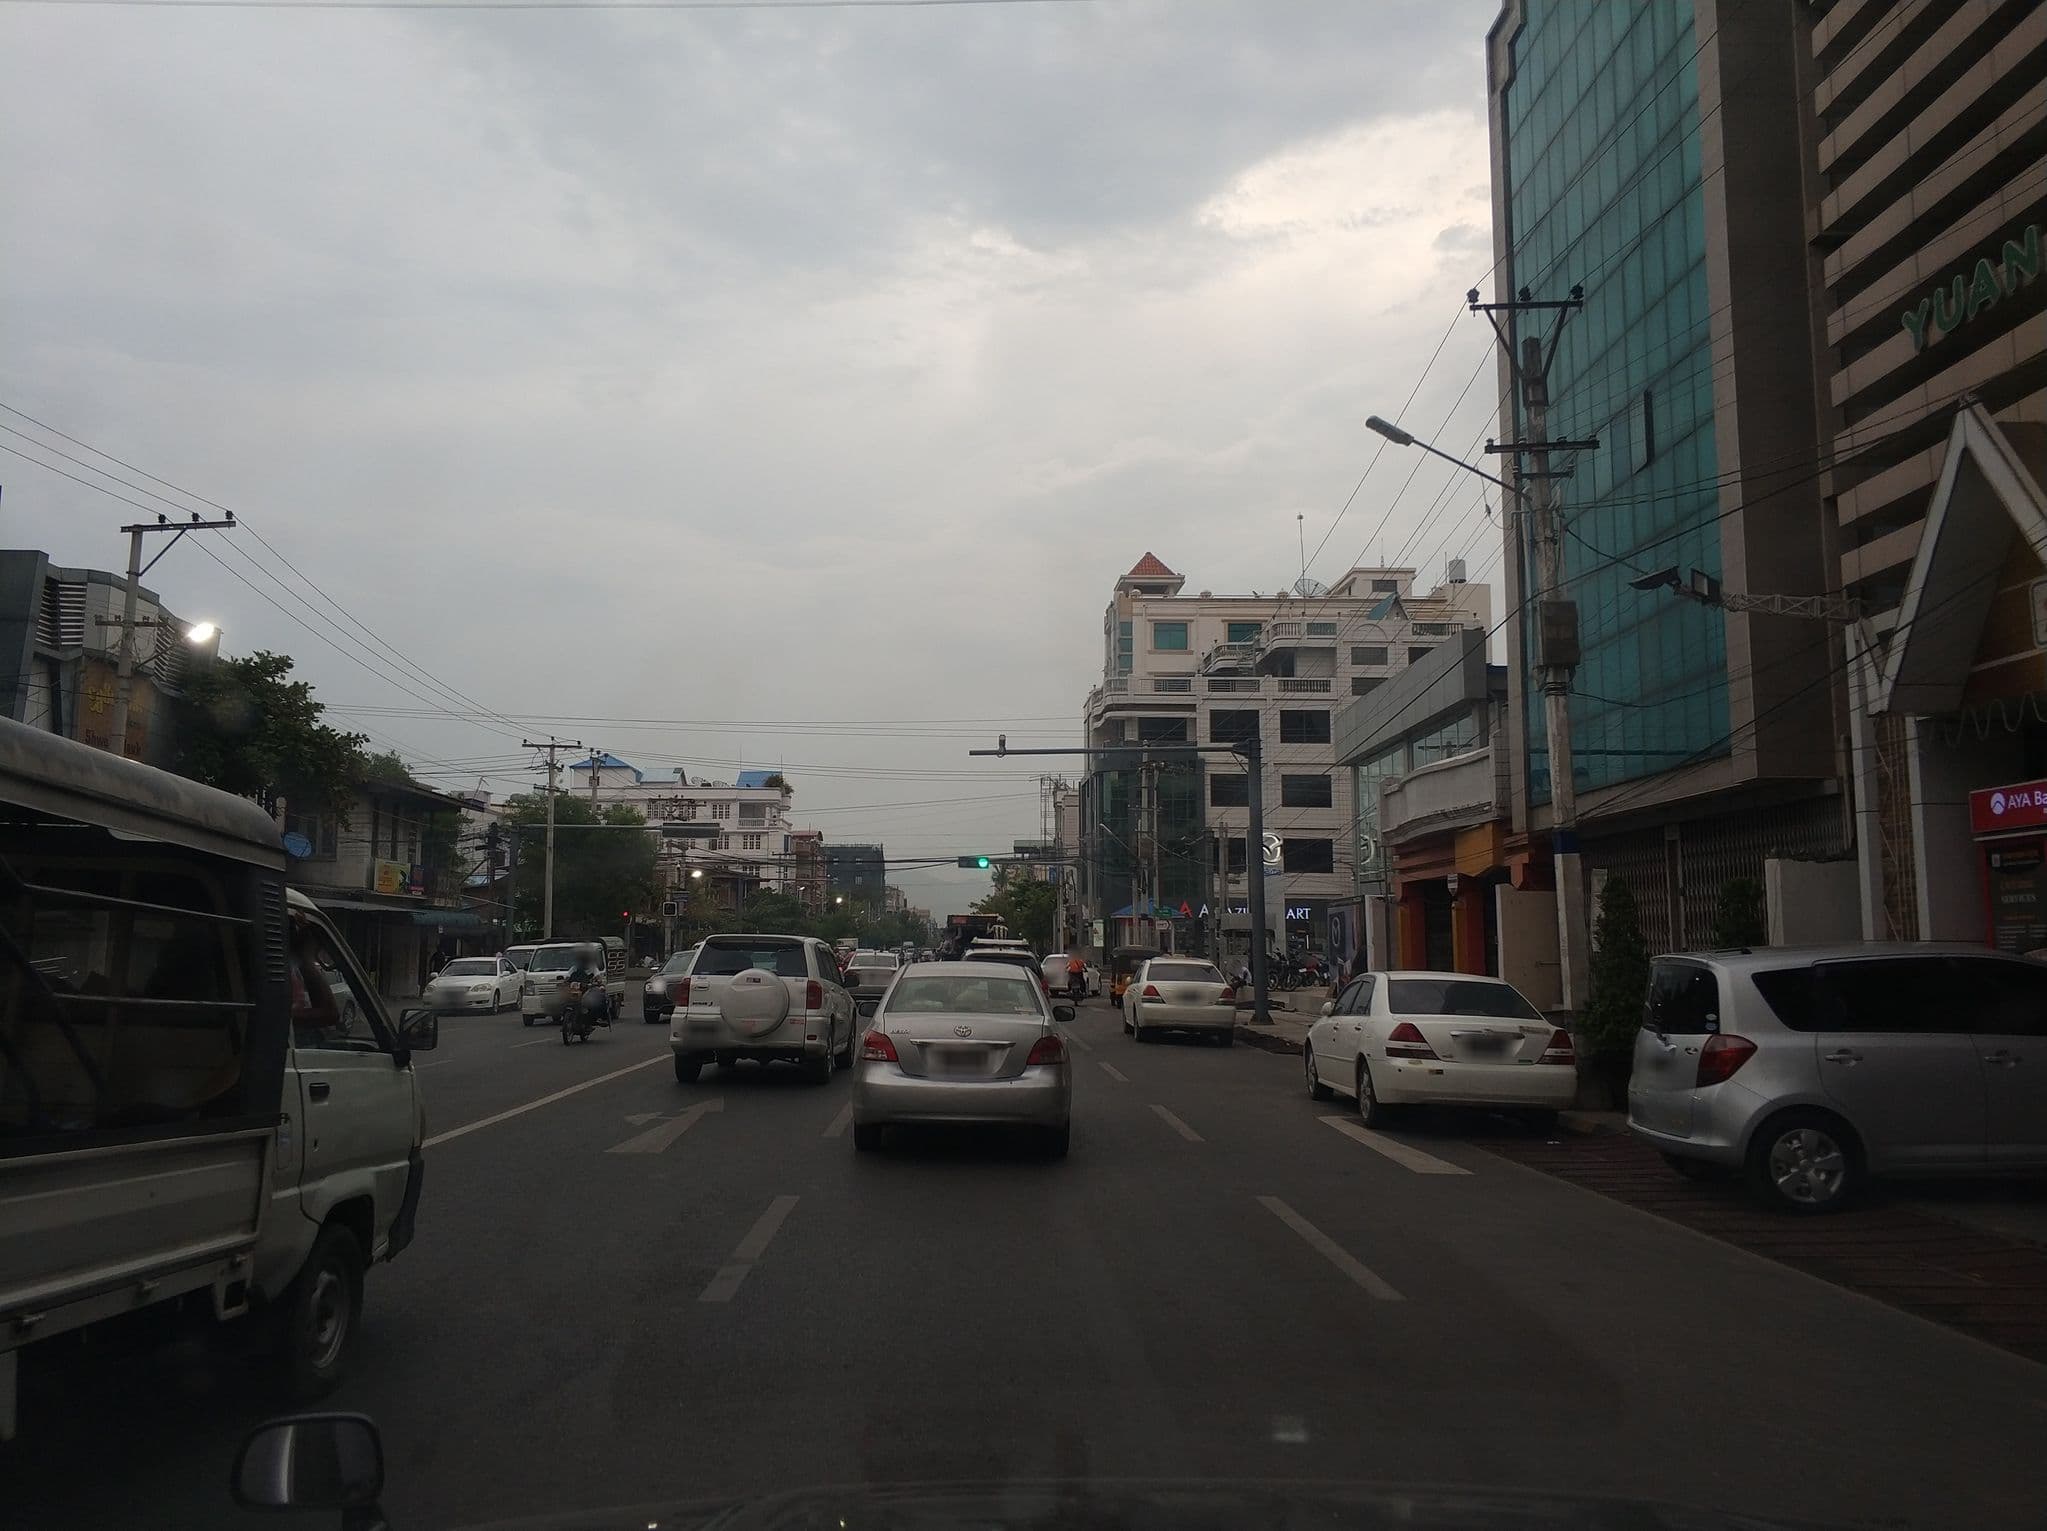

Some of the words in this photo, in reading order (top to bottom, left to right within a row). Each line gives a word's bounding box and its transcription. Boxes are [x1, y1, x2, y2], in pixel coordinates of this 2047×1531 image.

[1901, 225, 2039, 355] YUAN
[2008, 792, 2032, 808] AYA
[1286, 907, 1311, 920] ART
